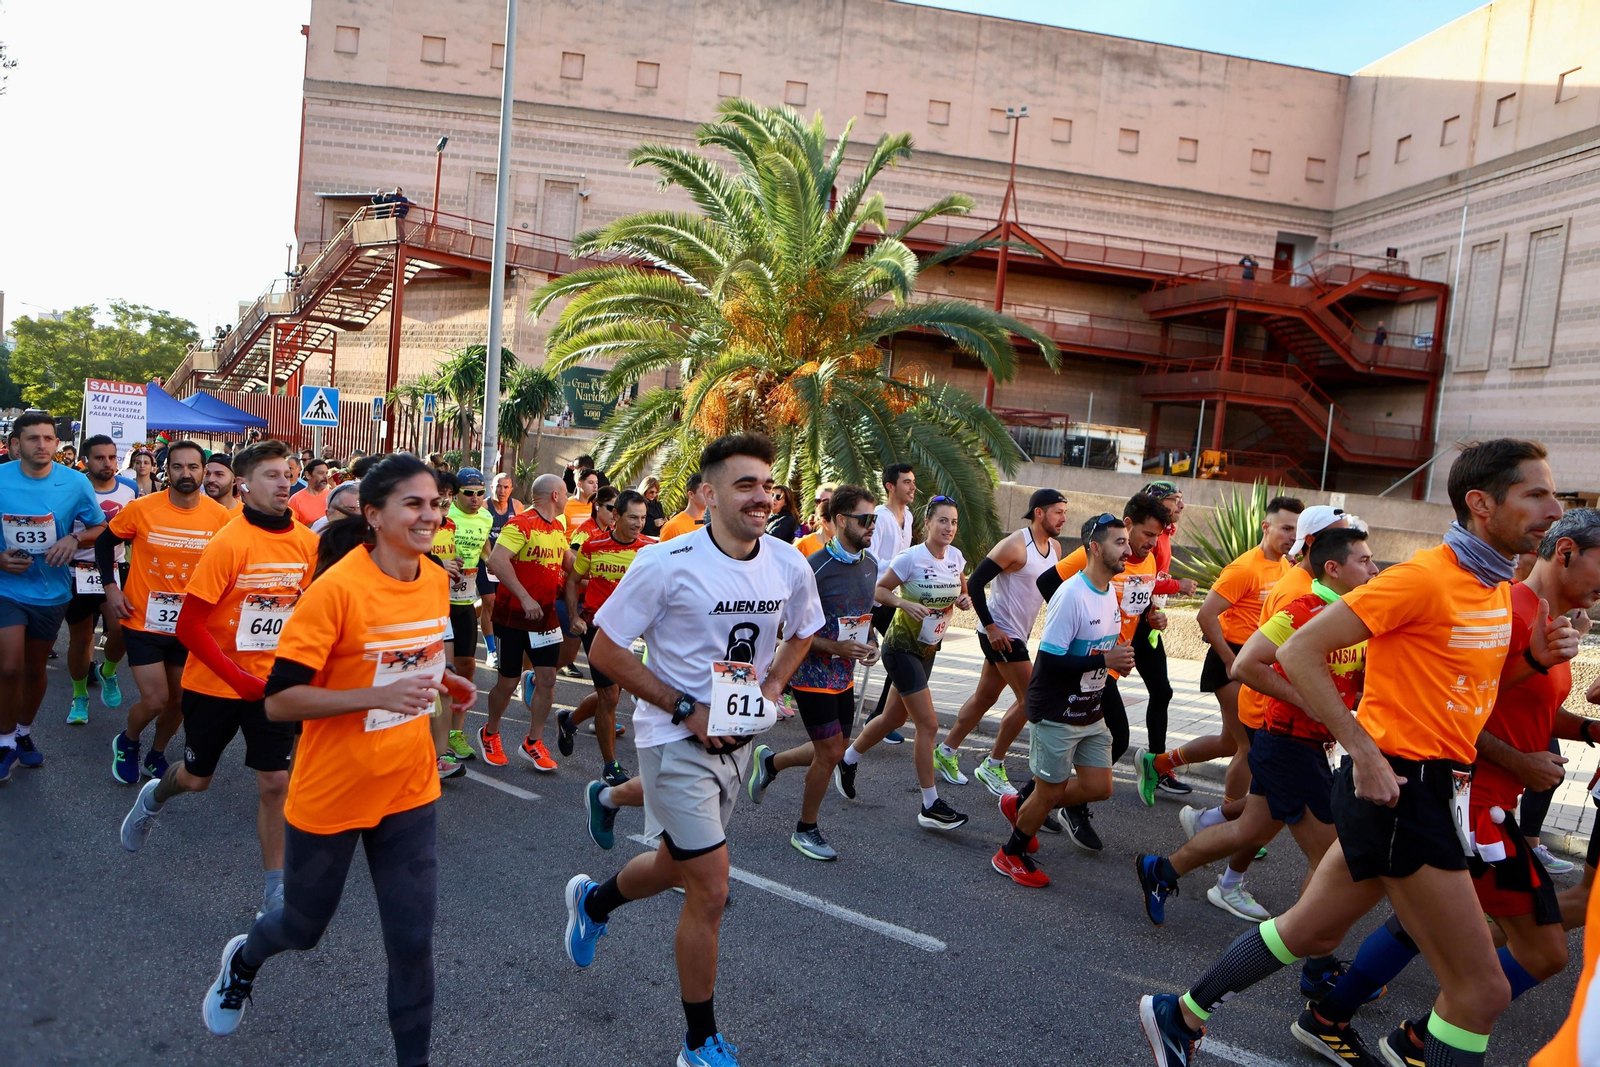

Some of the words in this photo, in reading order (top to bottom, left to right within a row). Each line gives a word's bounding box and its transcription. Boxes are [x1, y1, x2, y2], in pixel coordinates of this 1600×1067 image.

[90, 381, 144, 395] SALIDA
[572, 378, 590, 389] Gran
[92, 394, 110, 403] XII
[15, 531, 47, 543] 633
[431, 545, 447, 554] NSIA
[86, 575, 102, 585] 48
[1129, 592, 1149, 605] 399
[713, 601, 755, 613] ALIEN
[757, 600, 782, 612] BOX
[158, 609, 178, 623] 32
[251, 618, 283, 635] 640
[727, 693, 765, 718] 611
